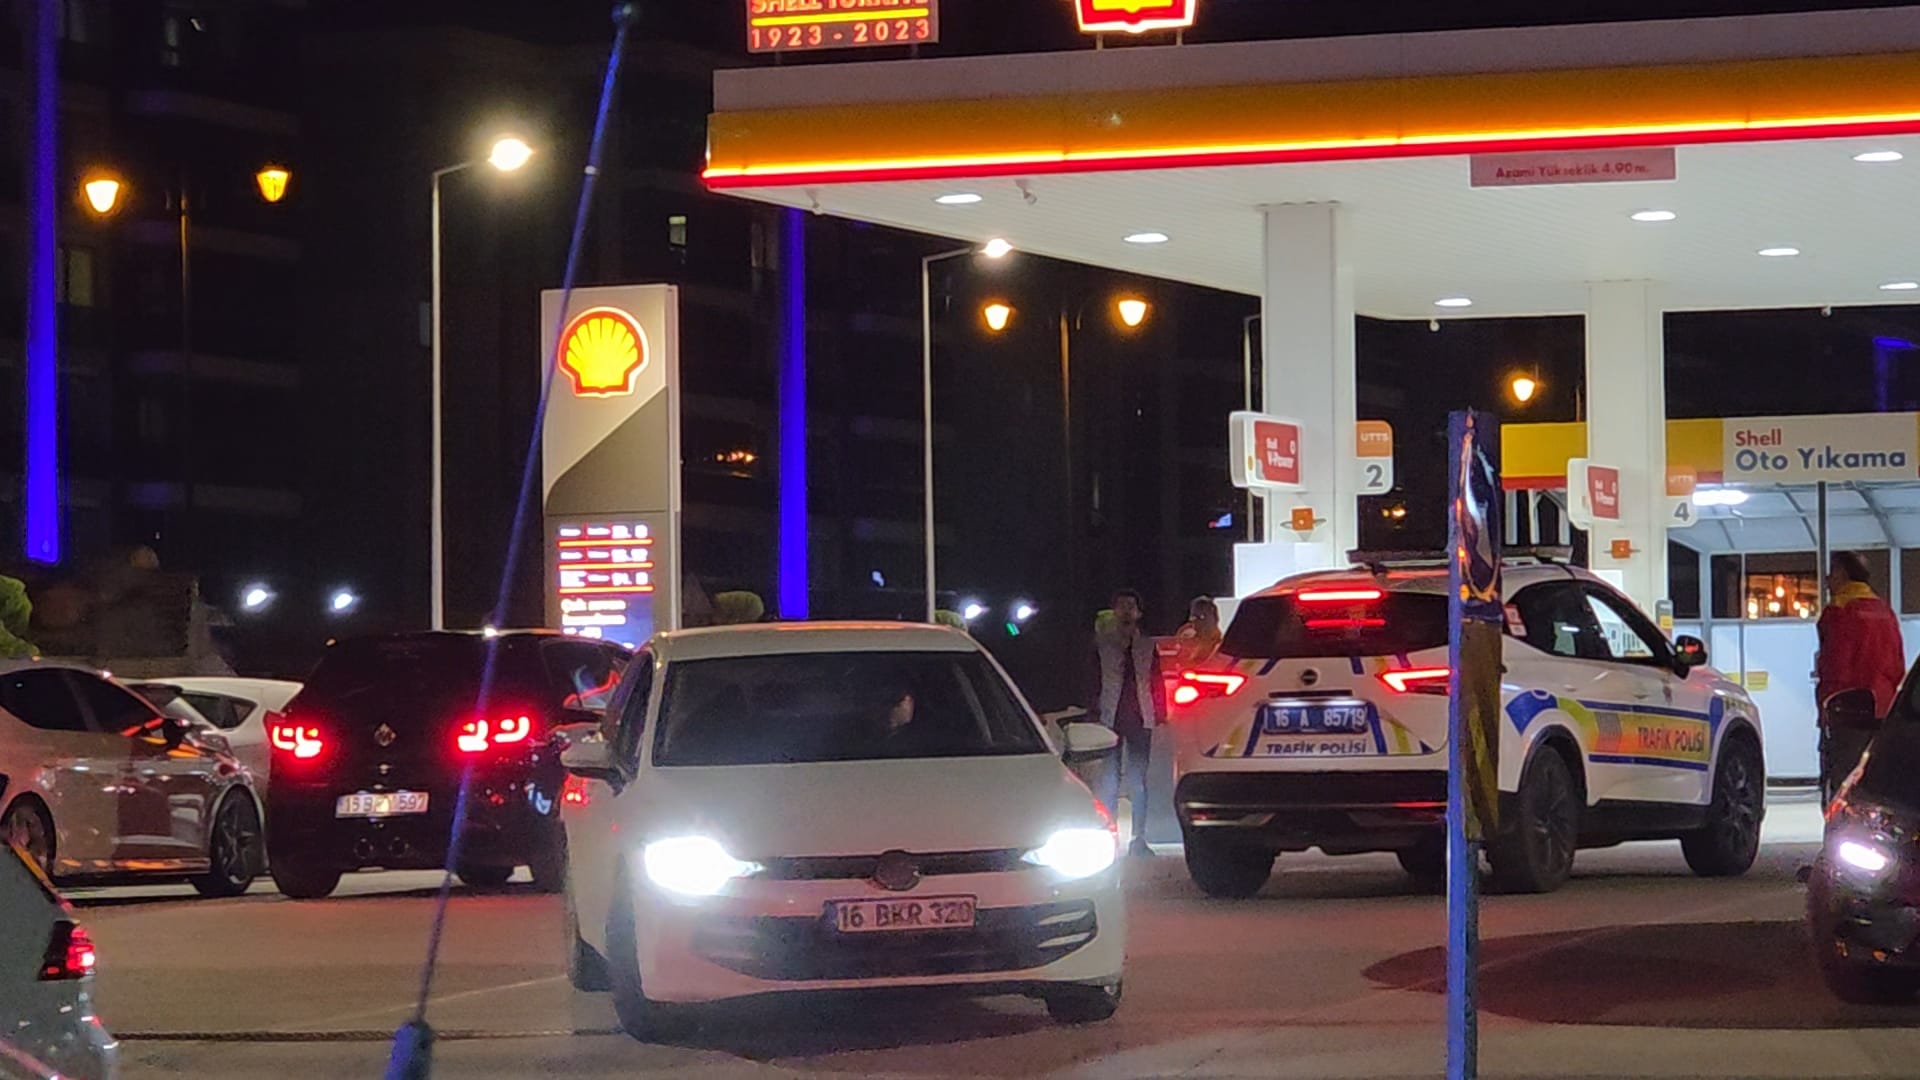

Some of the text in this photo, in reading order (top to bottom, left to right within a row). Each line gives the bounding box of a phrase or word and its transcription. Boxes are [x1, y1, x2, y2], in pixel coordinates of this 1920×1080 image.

[752, 25, 822, 48] 1923
[853, 19, 929, 43] 2023
[1496, 166, 1535, 178] Azami
[1735, 428, 1782, 447] Shell
[1736, 446, 1906, 471] Oto Yıkama
[1366, 464, 1384, 487] 2
[1674, 502, 1689, 521] 4
[1275, 709, 1290, 727] 16
[1300, 709, 1310, 727] A
[1266, 740, 1367, 753] TRAFİK POLİSİ
[1638, 725, 1671, 750] TRAFİK
[840, 904, 864, 928] 16
[876, 903, 923, 927] BKR
